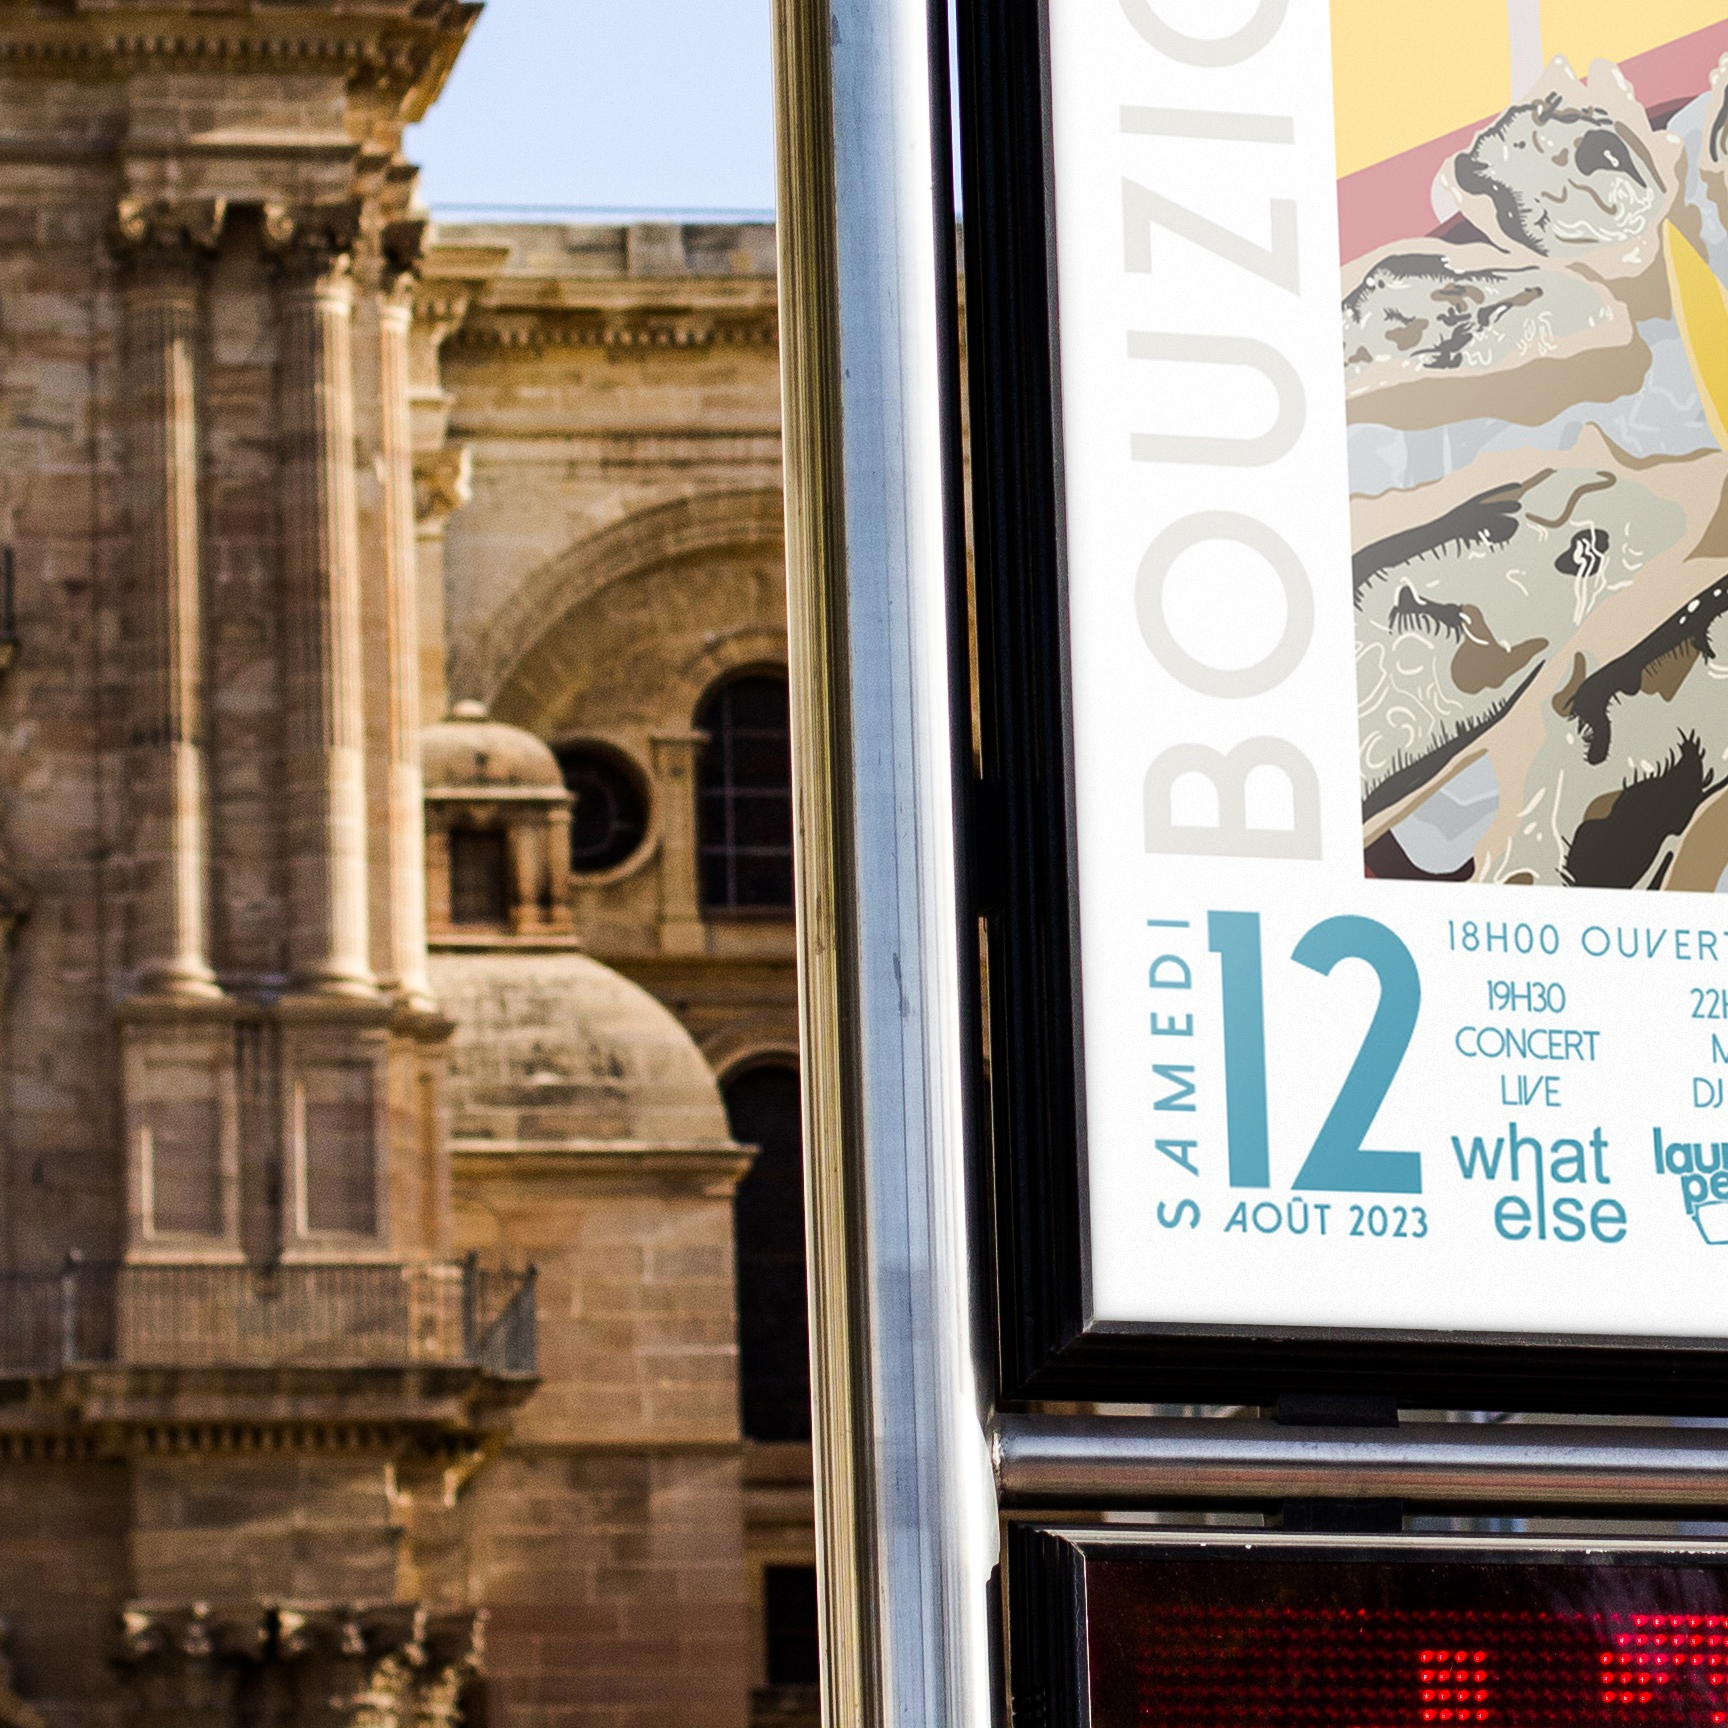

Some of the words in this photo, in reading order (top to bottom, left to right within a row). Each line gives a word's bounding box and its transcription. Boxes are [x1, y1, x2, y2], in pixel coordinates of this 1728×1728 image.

[1449, 920, 1559, 955] 18H00
[1487, 980, 1566, 1014] 19H30
[1207, 910, 1423, 1194] 12
[1455, 1026, 1600, 1061] CONCERT
[1147, 918, 1201, 1229] SAMEDI
[1501, 1075, 1561, 1107] LIVE
[1693, 1077, 1723, 1109] DJ
[1451, 1121, 1610, 1184] what
[1493, 1151, 1628, 1243] else
[1224, 1196, 1331, 1235] AOÛT
[1349, 1204, 1428, 1238] 2023
